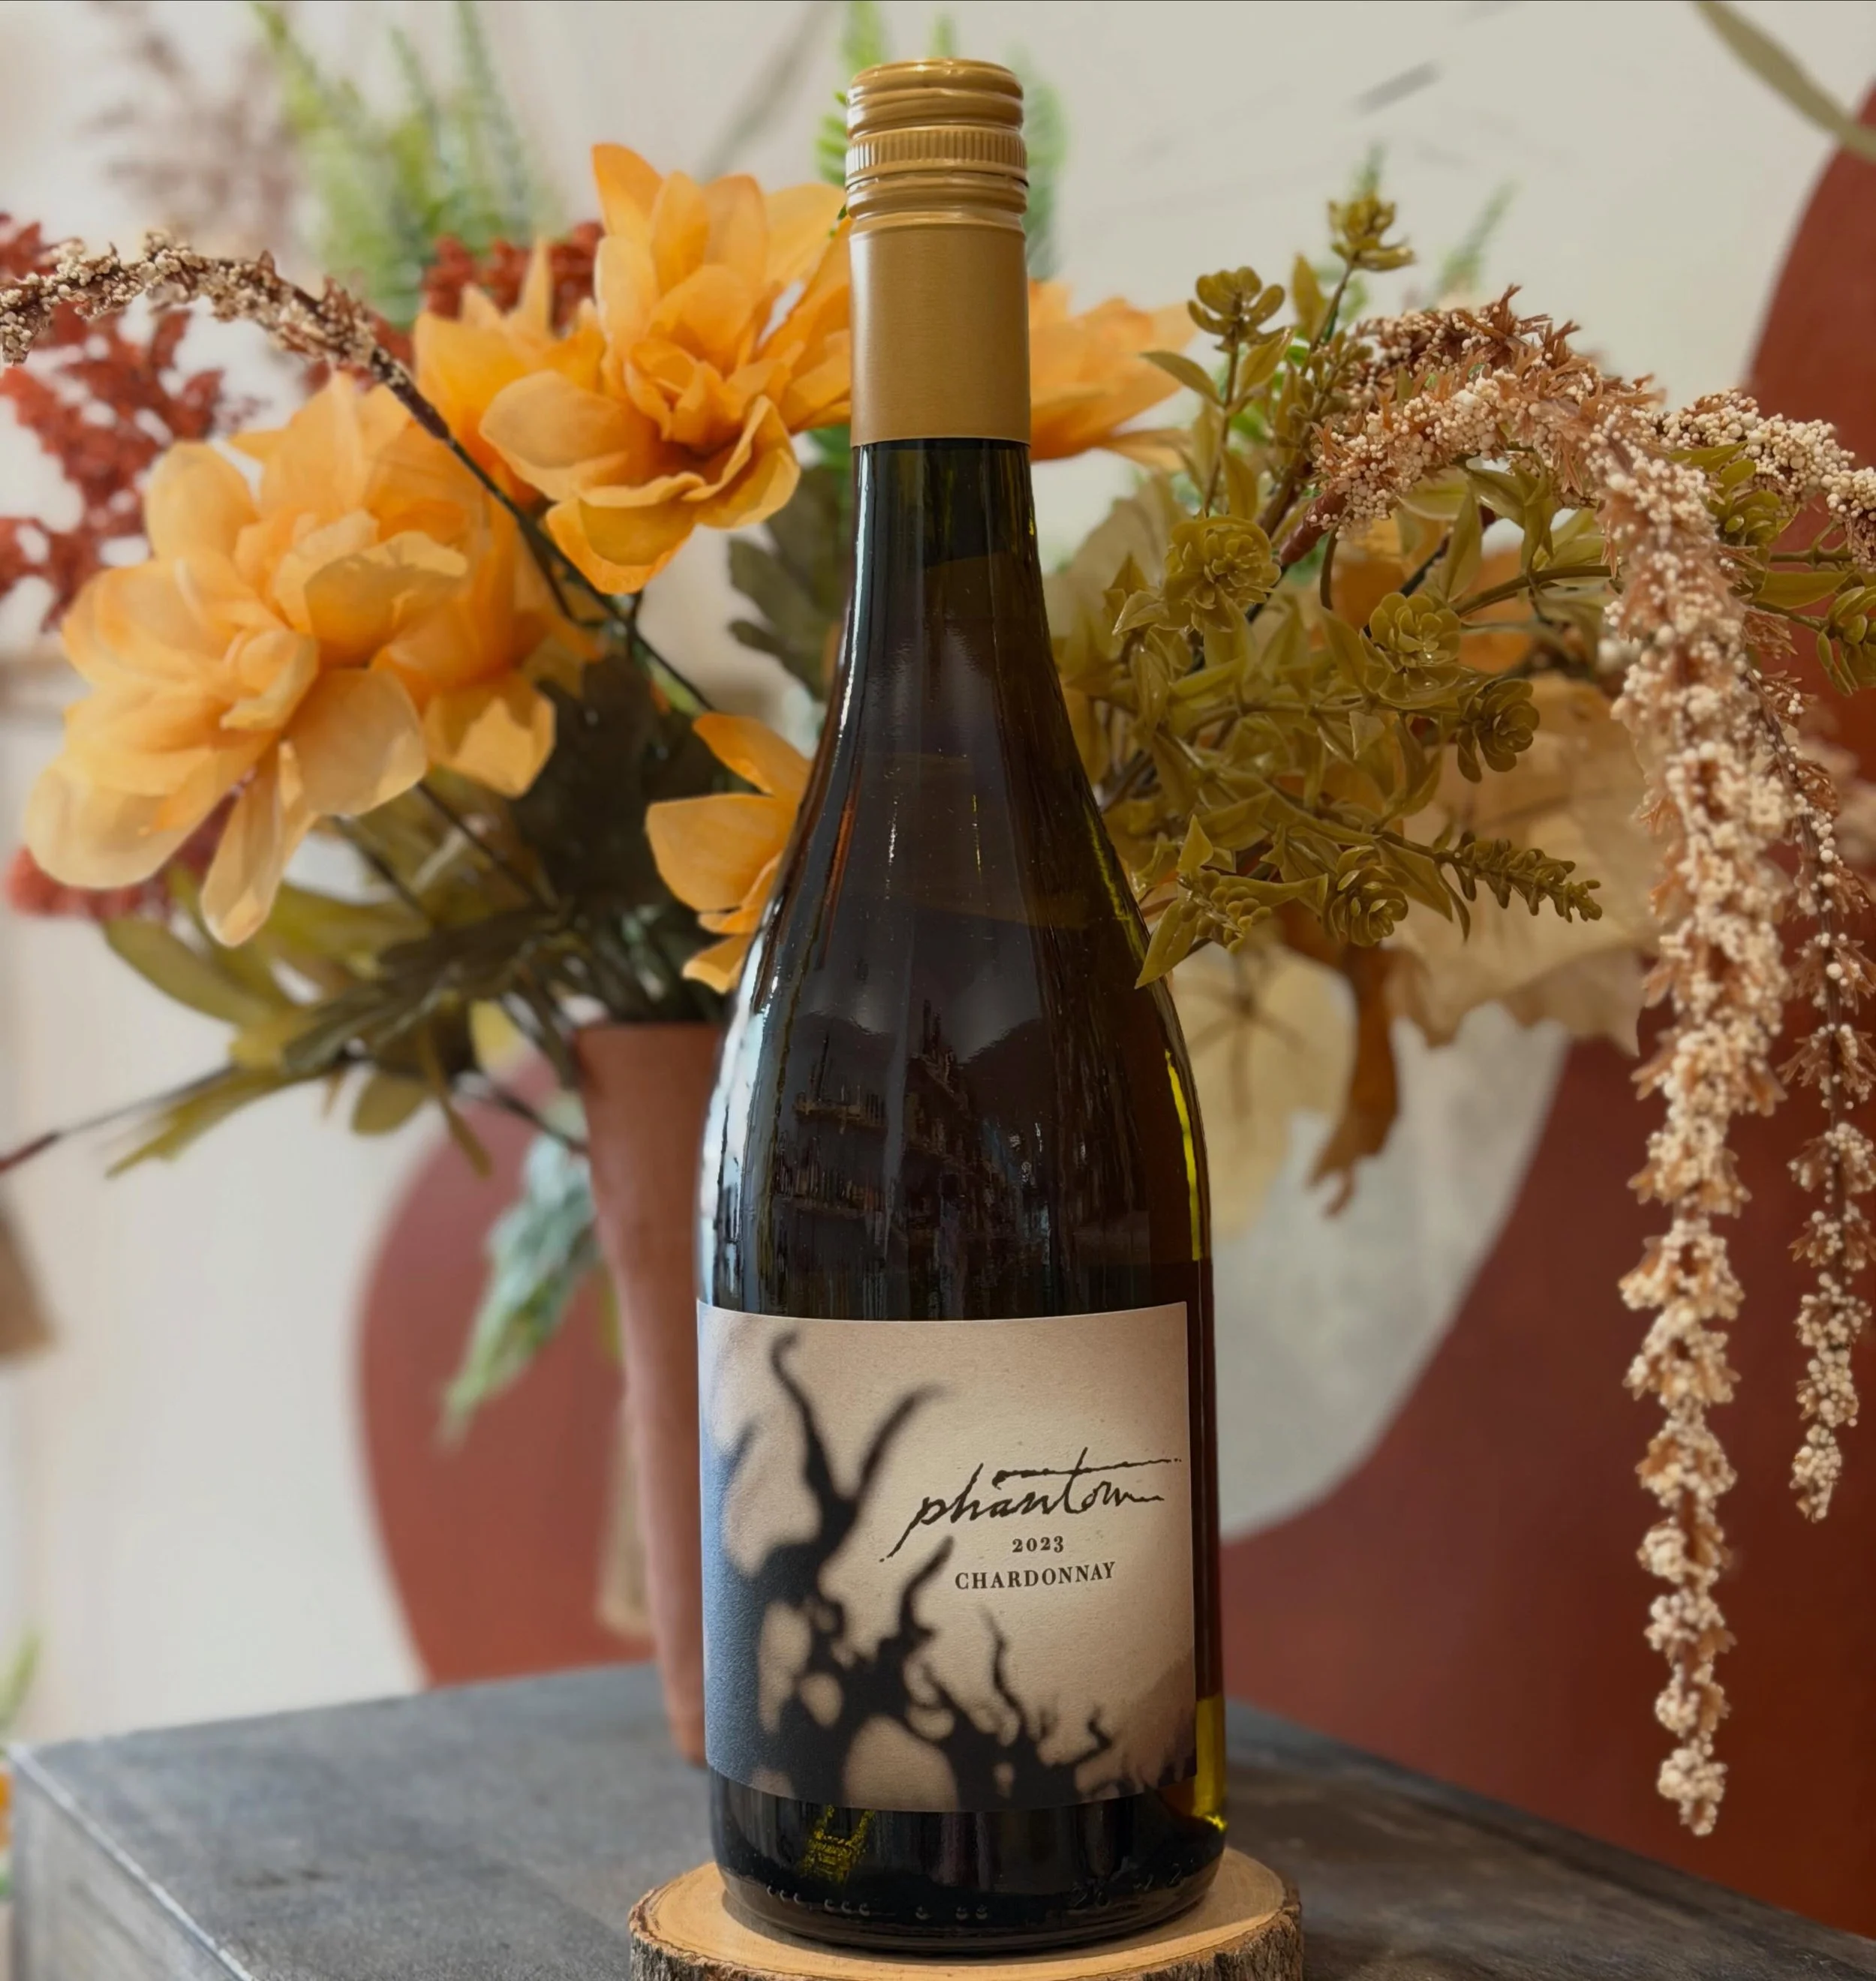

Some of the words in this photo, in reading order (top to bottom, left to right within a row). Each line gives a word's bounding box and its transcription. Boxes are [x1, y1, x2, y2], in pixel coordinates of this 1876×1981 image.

[879, 1447, 1182, 1562] phantom
[1012, 1535, 1064, 1553] 2023
[955, 1561, 1116, 1590] CHARDONNAY
